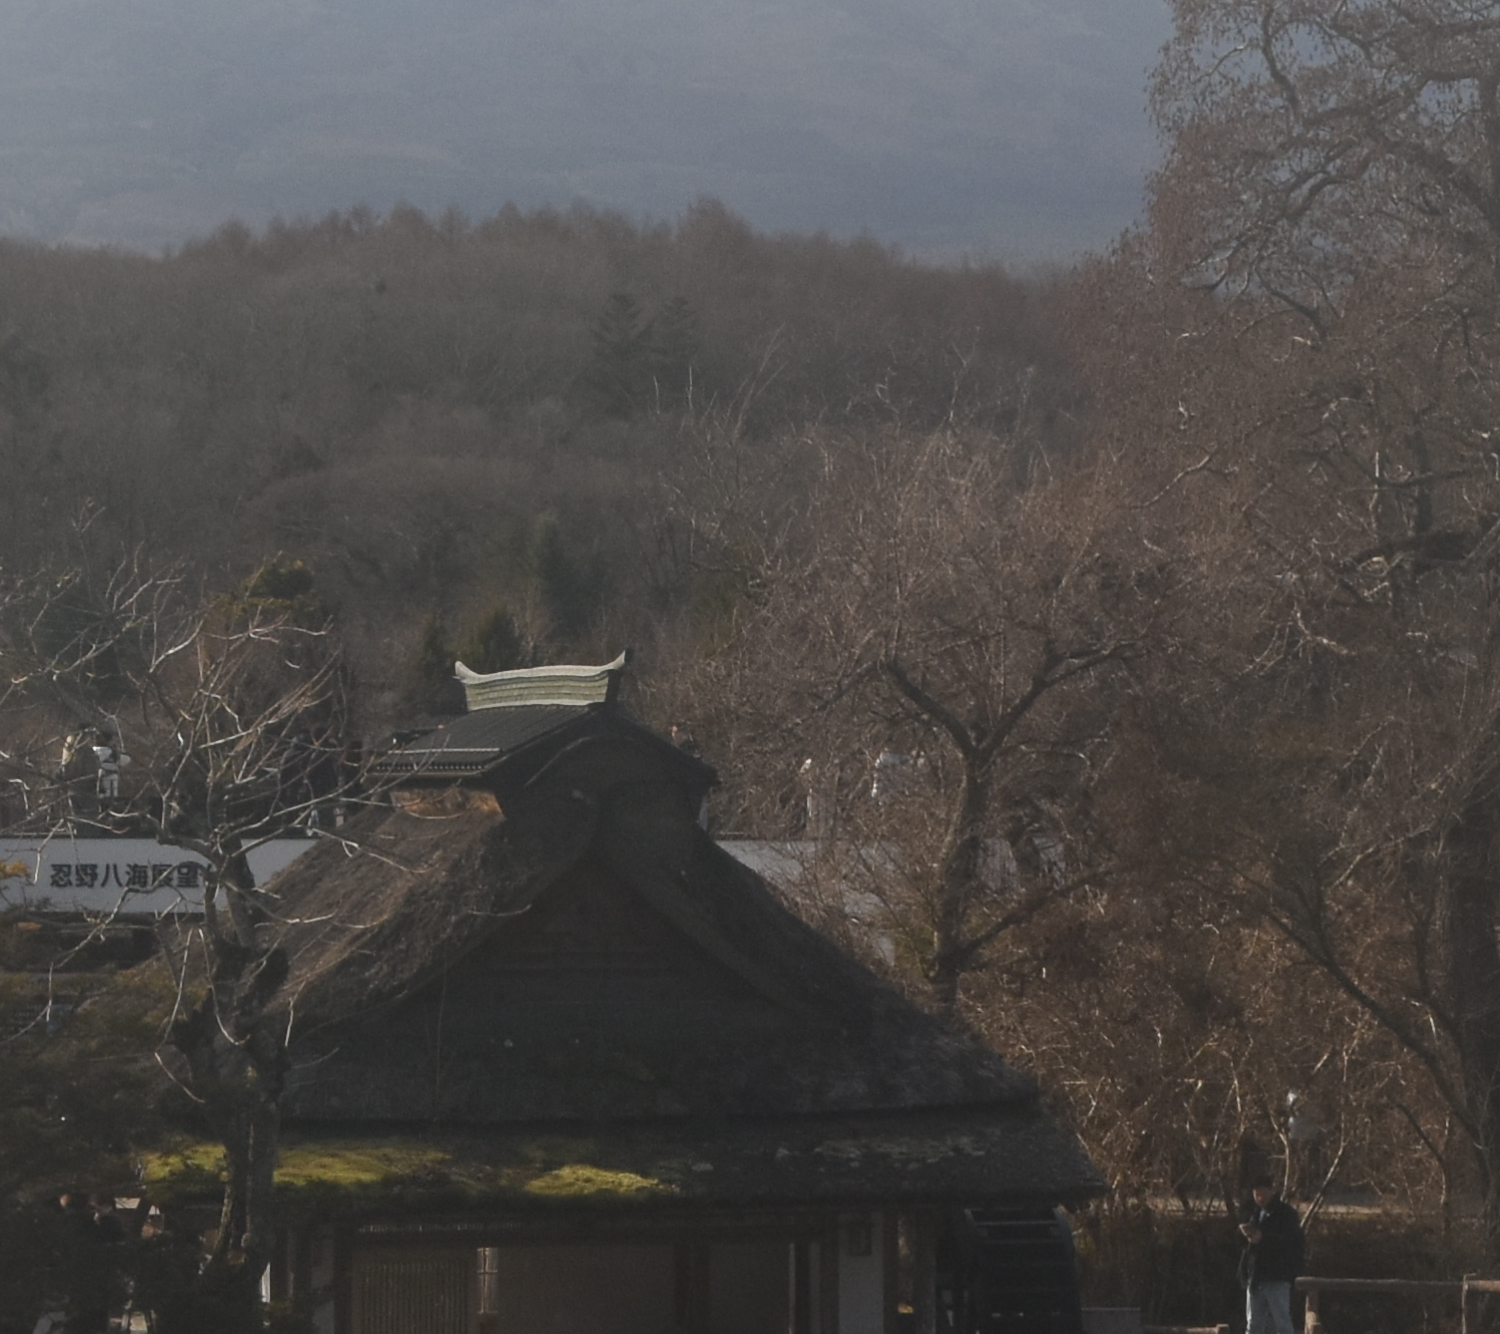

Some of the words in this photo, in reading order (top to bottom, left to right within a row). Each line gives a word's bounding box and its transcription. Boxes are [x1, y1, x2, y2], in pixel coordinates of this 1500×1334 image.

[51, 864, 217, 889] 忍野八海展望
